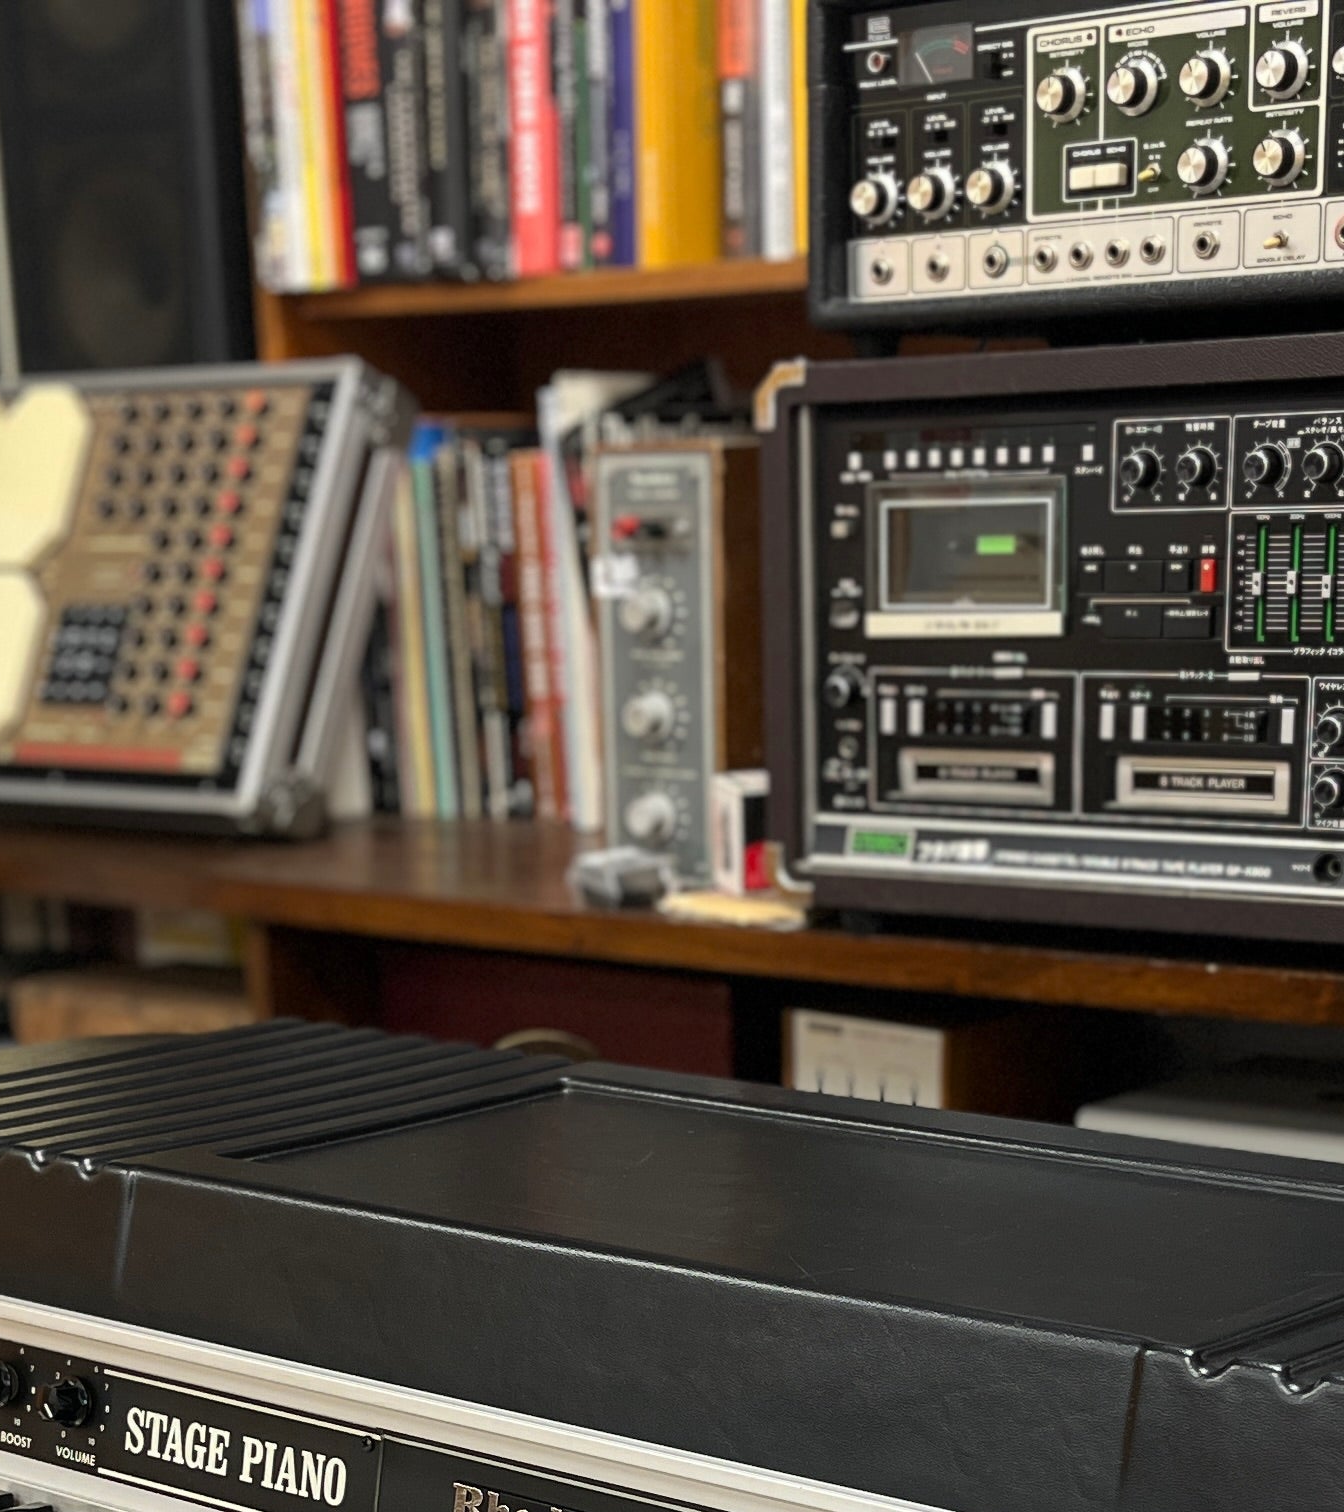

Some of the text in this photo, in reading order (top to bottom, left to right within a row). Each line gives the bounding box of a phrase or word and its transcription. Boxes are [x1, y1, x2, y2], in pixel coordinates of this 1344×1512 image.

[1271, 6, 1306, 16] REVERB
[1126, 26, 1155, 36] ECHO
[1040, 35, 1083, 48] CHORUS
[1171, 777, 1203, 787] TRACK
[1208, 779, 1246, 789] PLAYER
[0, 1431, 32, 1448] BOOST
[56, 1445, 96, 1466] VOLUME
[125, 1406, 347, 1507] STAGE PIANO
